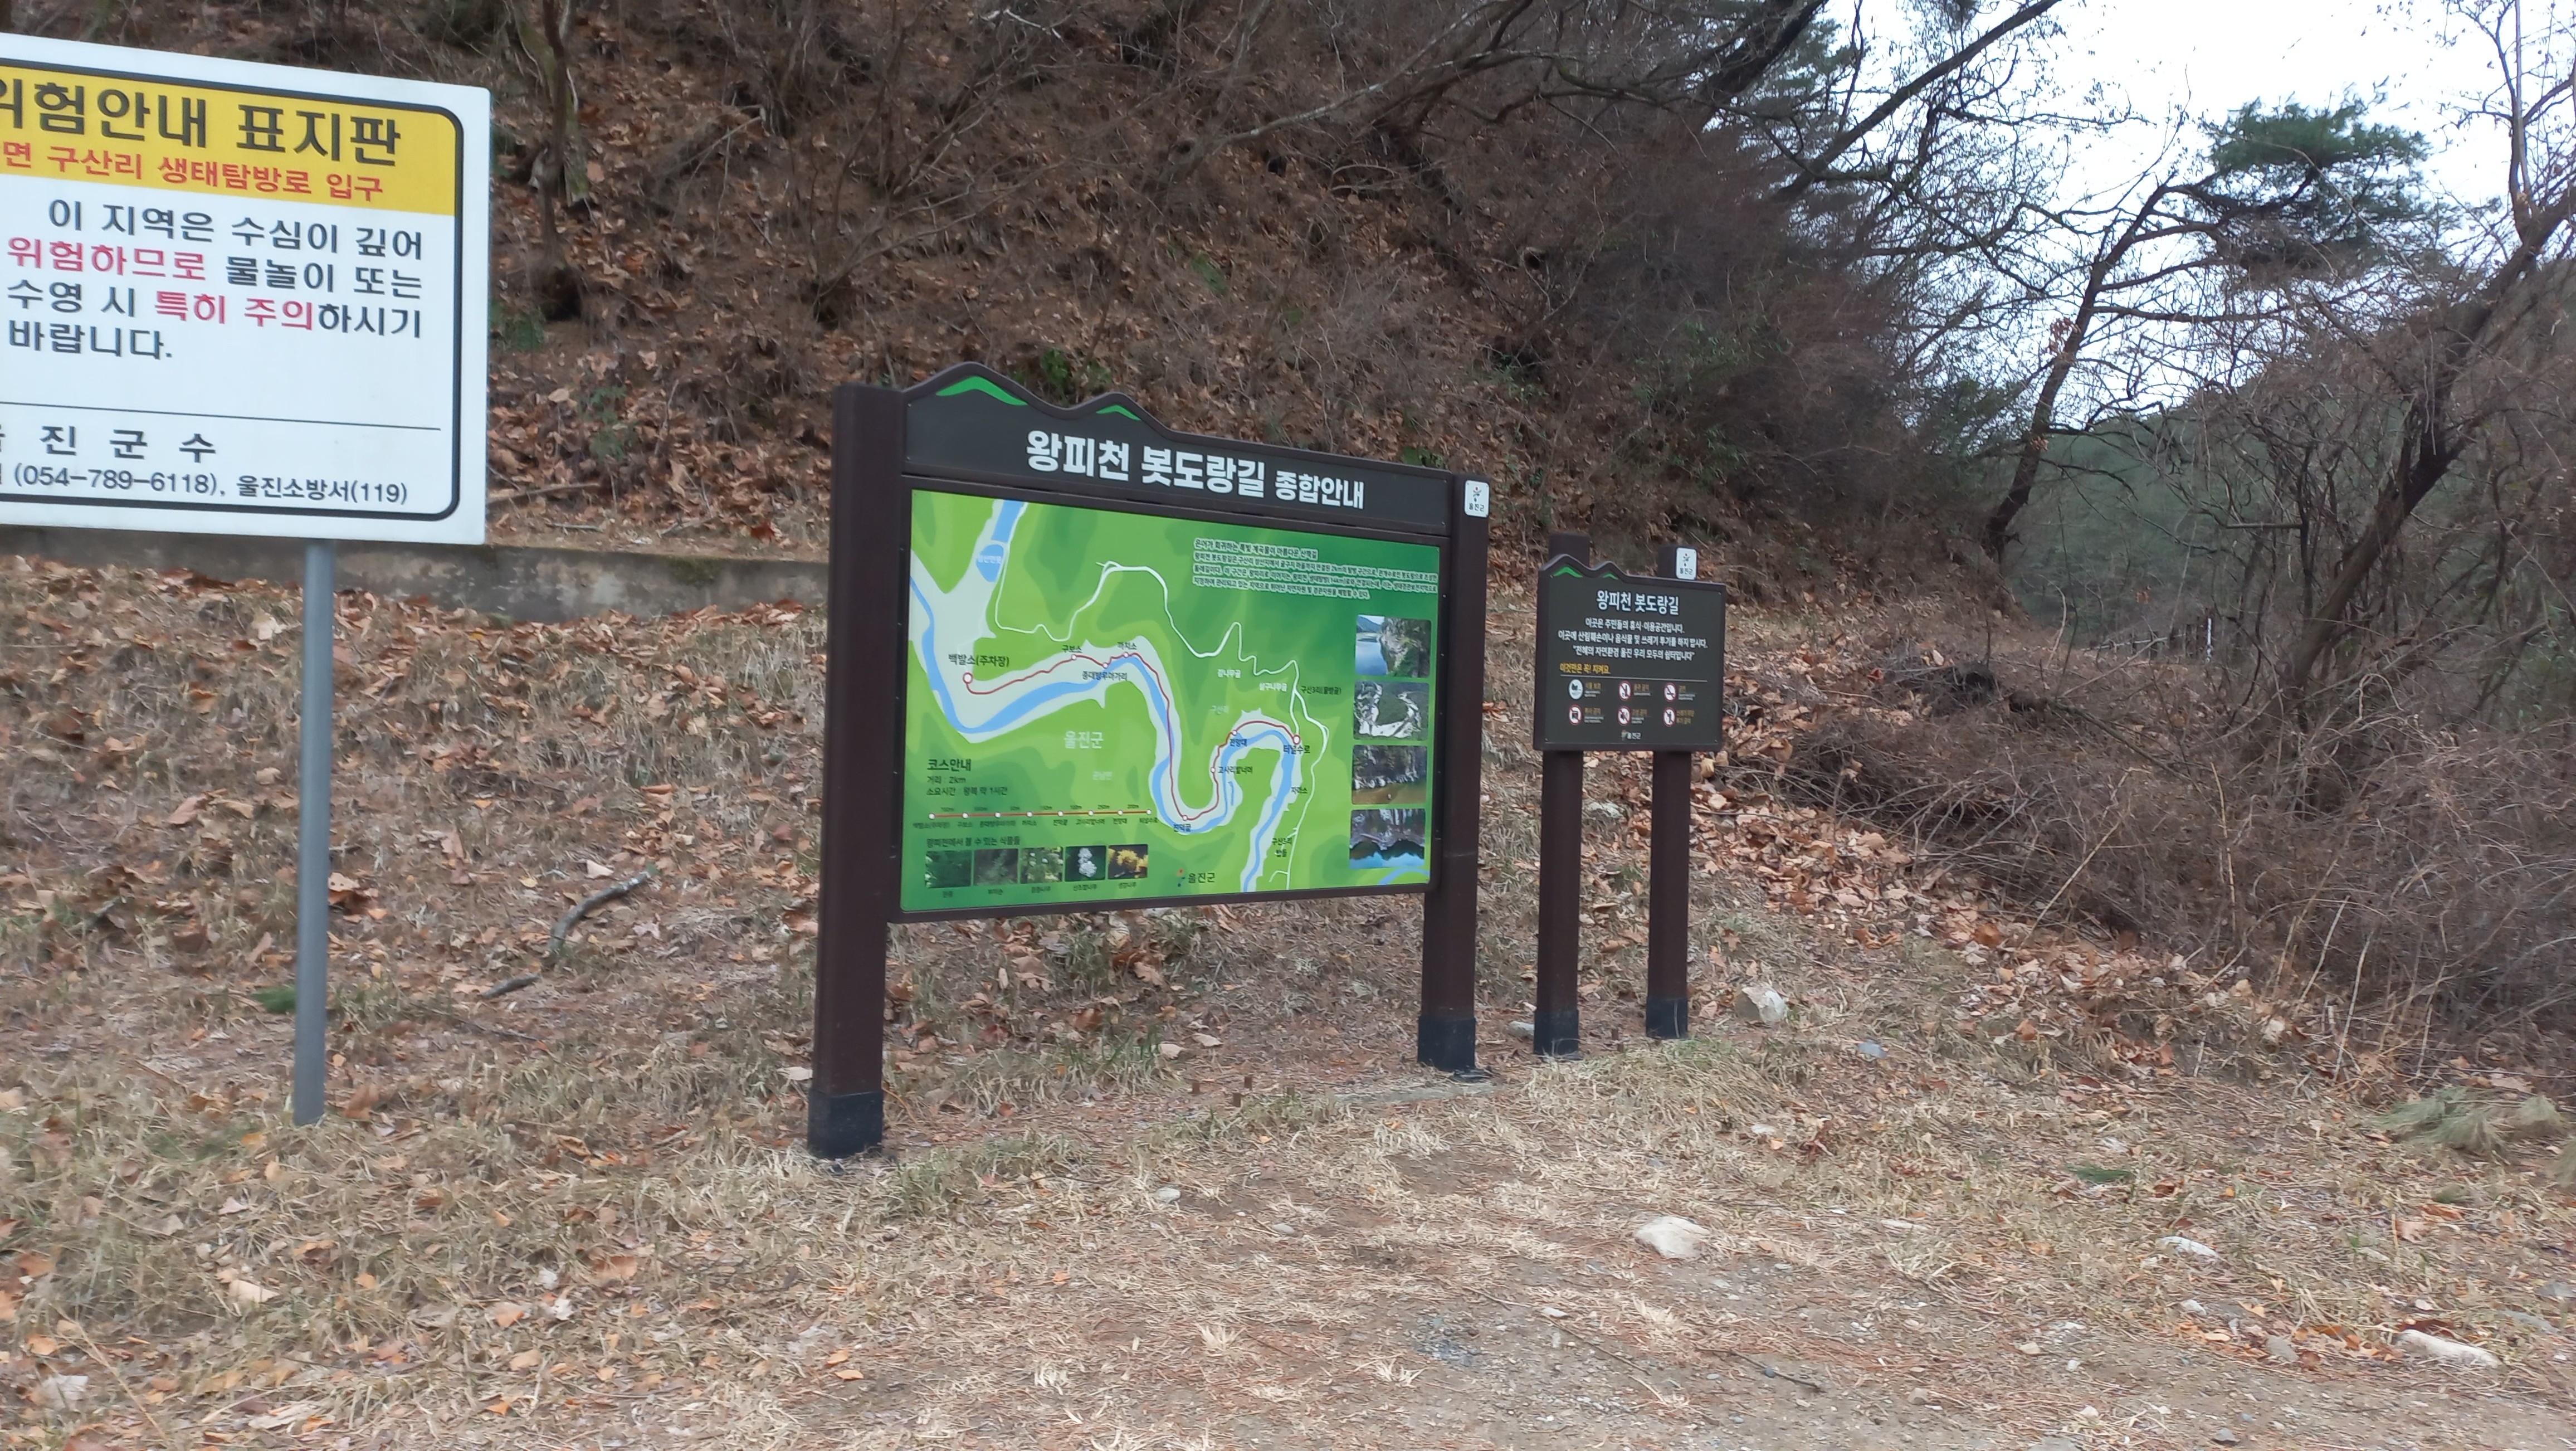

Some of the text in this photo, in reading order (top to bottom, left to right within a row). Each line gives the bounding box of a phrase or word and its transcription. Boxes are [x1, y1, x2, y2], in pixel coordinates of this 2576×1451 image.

[237, 103, 401, 167] 표지판
[3, 142, 384, 202] 면 구산리 생태탐방로 입구
[49, 199, 422, 260] 이 지역은 수심이 깊어
[7, 237, 422, 299] 위험하므로 물놀이 또는
[7, 279, 421, 338] 수영 시 특히 주의하시기
[8, 320, 172, 360] 바랍니다.
[237, 475, 408, 504] 울진소방서(119)
[1026, 429, 1364, 509] 왕피천 봇도랑길 종합안내
[1597, 590, 1679, 615] 왕피천 봇도랑길
[1064, 731, 1103, 749] 울진군
[927, 758, 972, 772] 코스안내
[1188, 873, 1215, 884] 울진군
